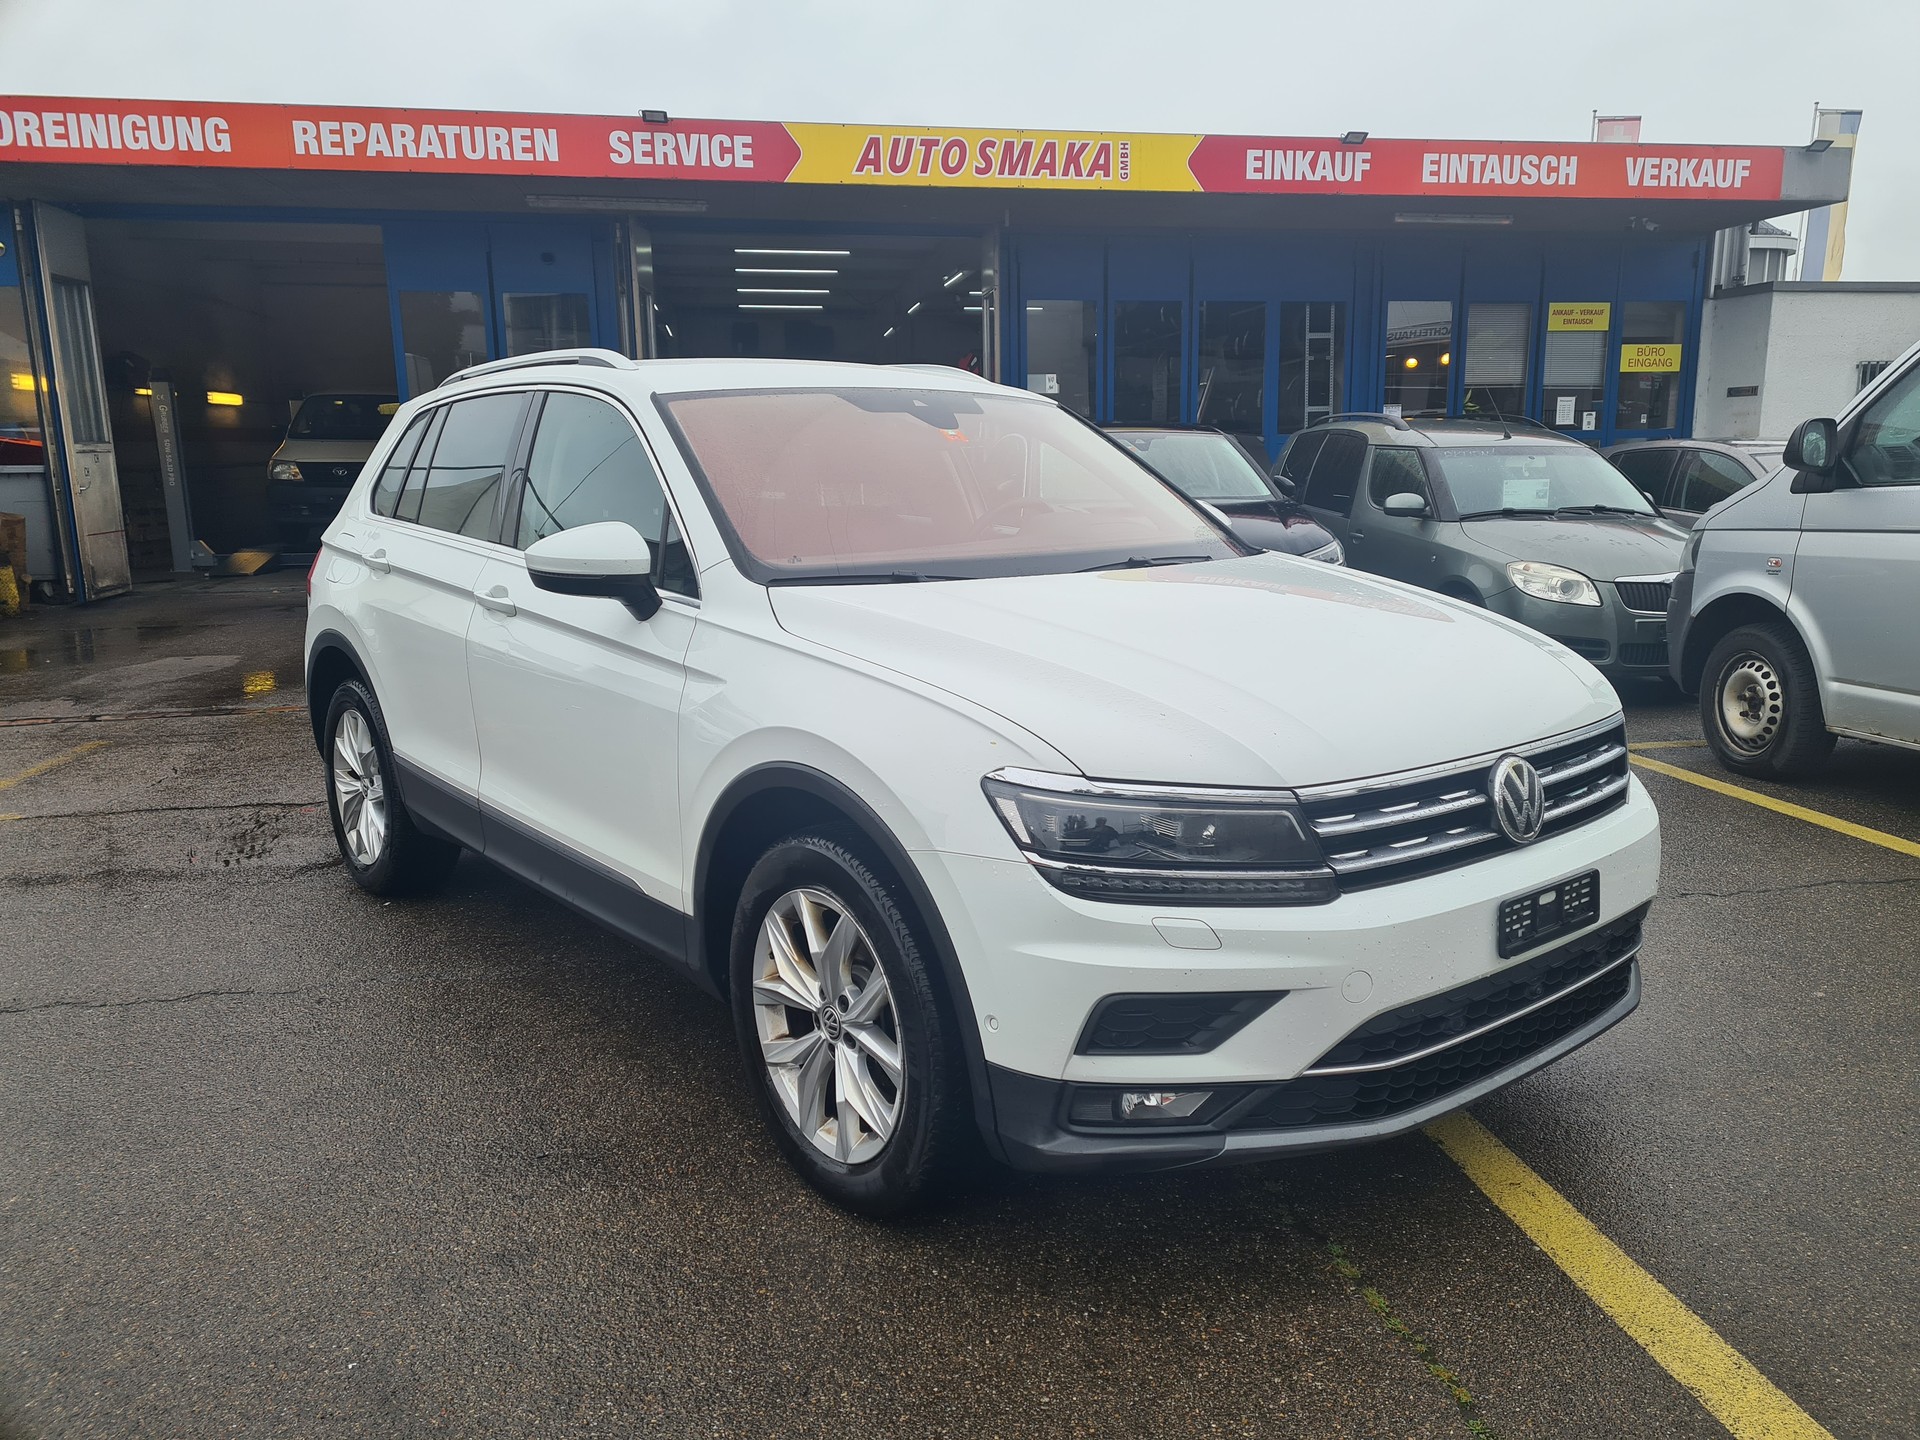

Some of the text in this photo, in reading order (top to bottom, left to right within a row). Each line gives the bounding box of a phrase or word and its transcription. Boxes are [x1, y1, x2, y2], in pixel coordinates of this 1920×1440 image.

[291, 119, 559, 162] REPARATUREN
[608, 130, 754, 168] SERVICE
[851, 134, 1113, 181] AUTO SMAKA
[1119, 141, 1131, 180] GMBH
[1245, 149, 1372, 182] EINKAUF
[1422, 153, 1578, 186] EINTAUSCH
[1625, 157, 1751, 188] VERKAUF
[1552, 308, 1575, 316] ANKAUF
[1579, 308, 1606, 316] VERKAUF
[1627, 358, 1673, 368] EINGANG
[1636, 345, 1667, 357] BÜRO
